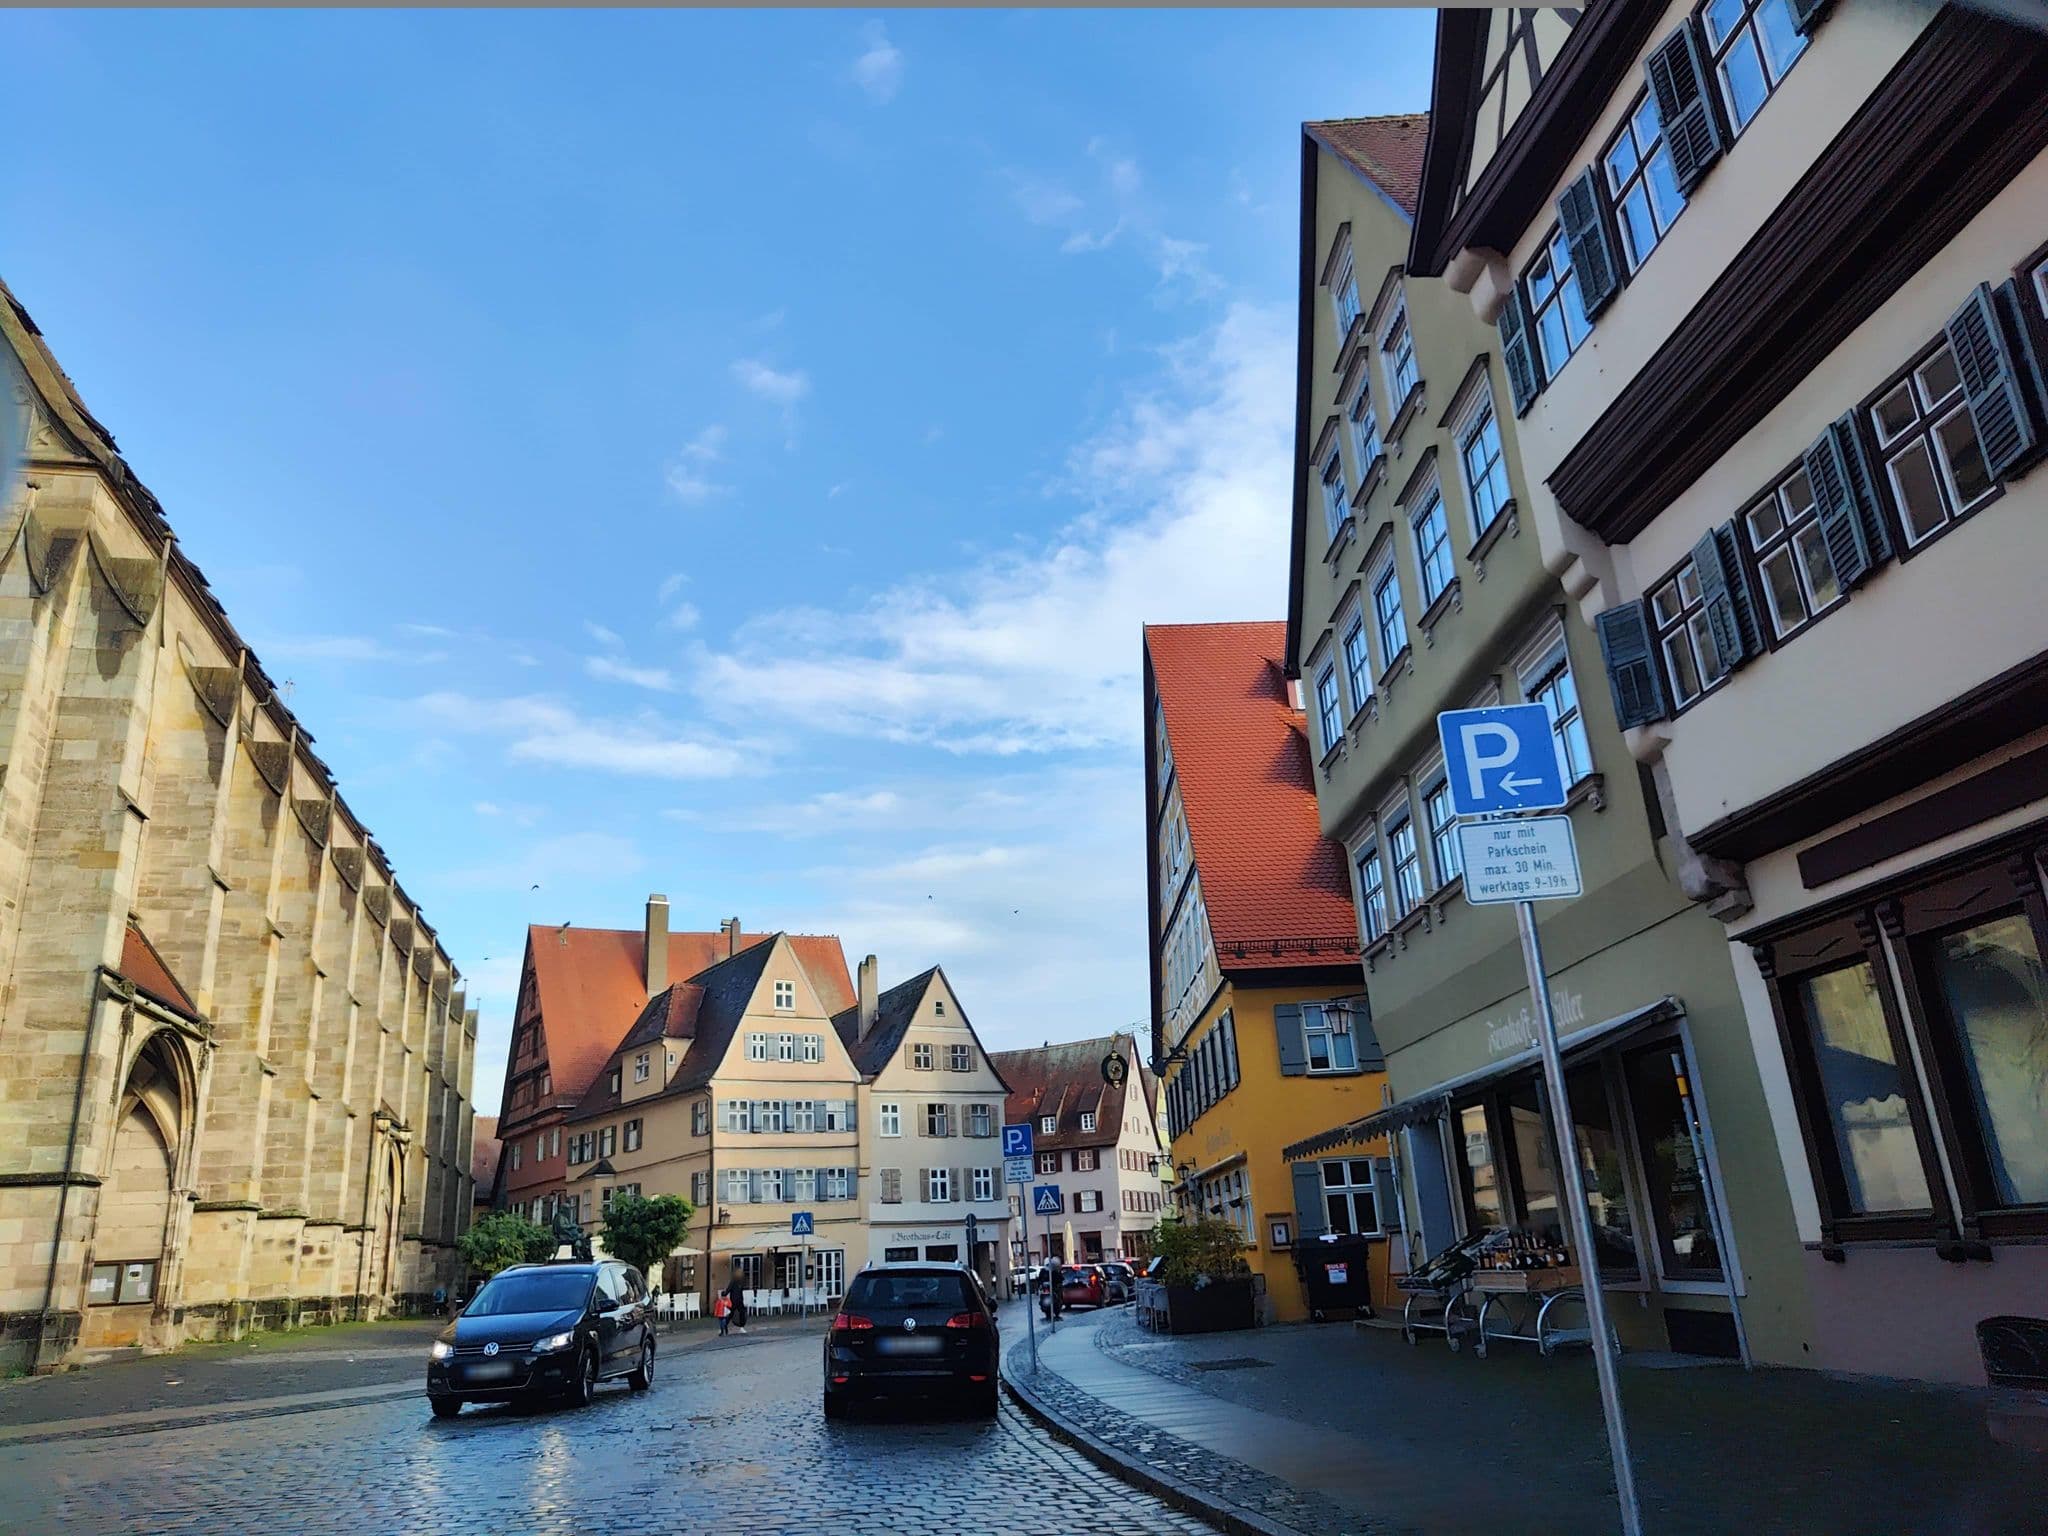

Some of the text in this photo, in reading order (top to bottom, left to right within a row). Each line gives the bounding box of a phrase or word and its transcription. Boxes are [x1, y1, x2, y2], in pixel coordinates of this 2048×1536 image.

[1460, 722, 1520, 800] P
[1493, 826, 1536, 841] nur mit
[1487, 842, 1547, 858] Parkschein
[1484, 857, 1556, 876] max. 30 Min.
[1479, 878, 1531, 894] werktags
[1006, 1129, 1023, 1153] P
